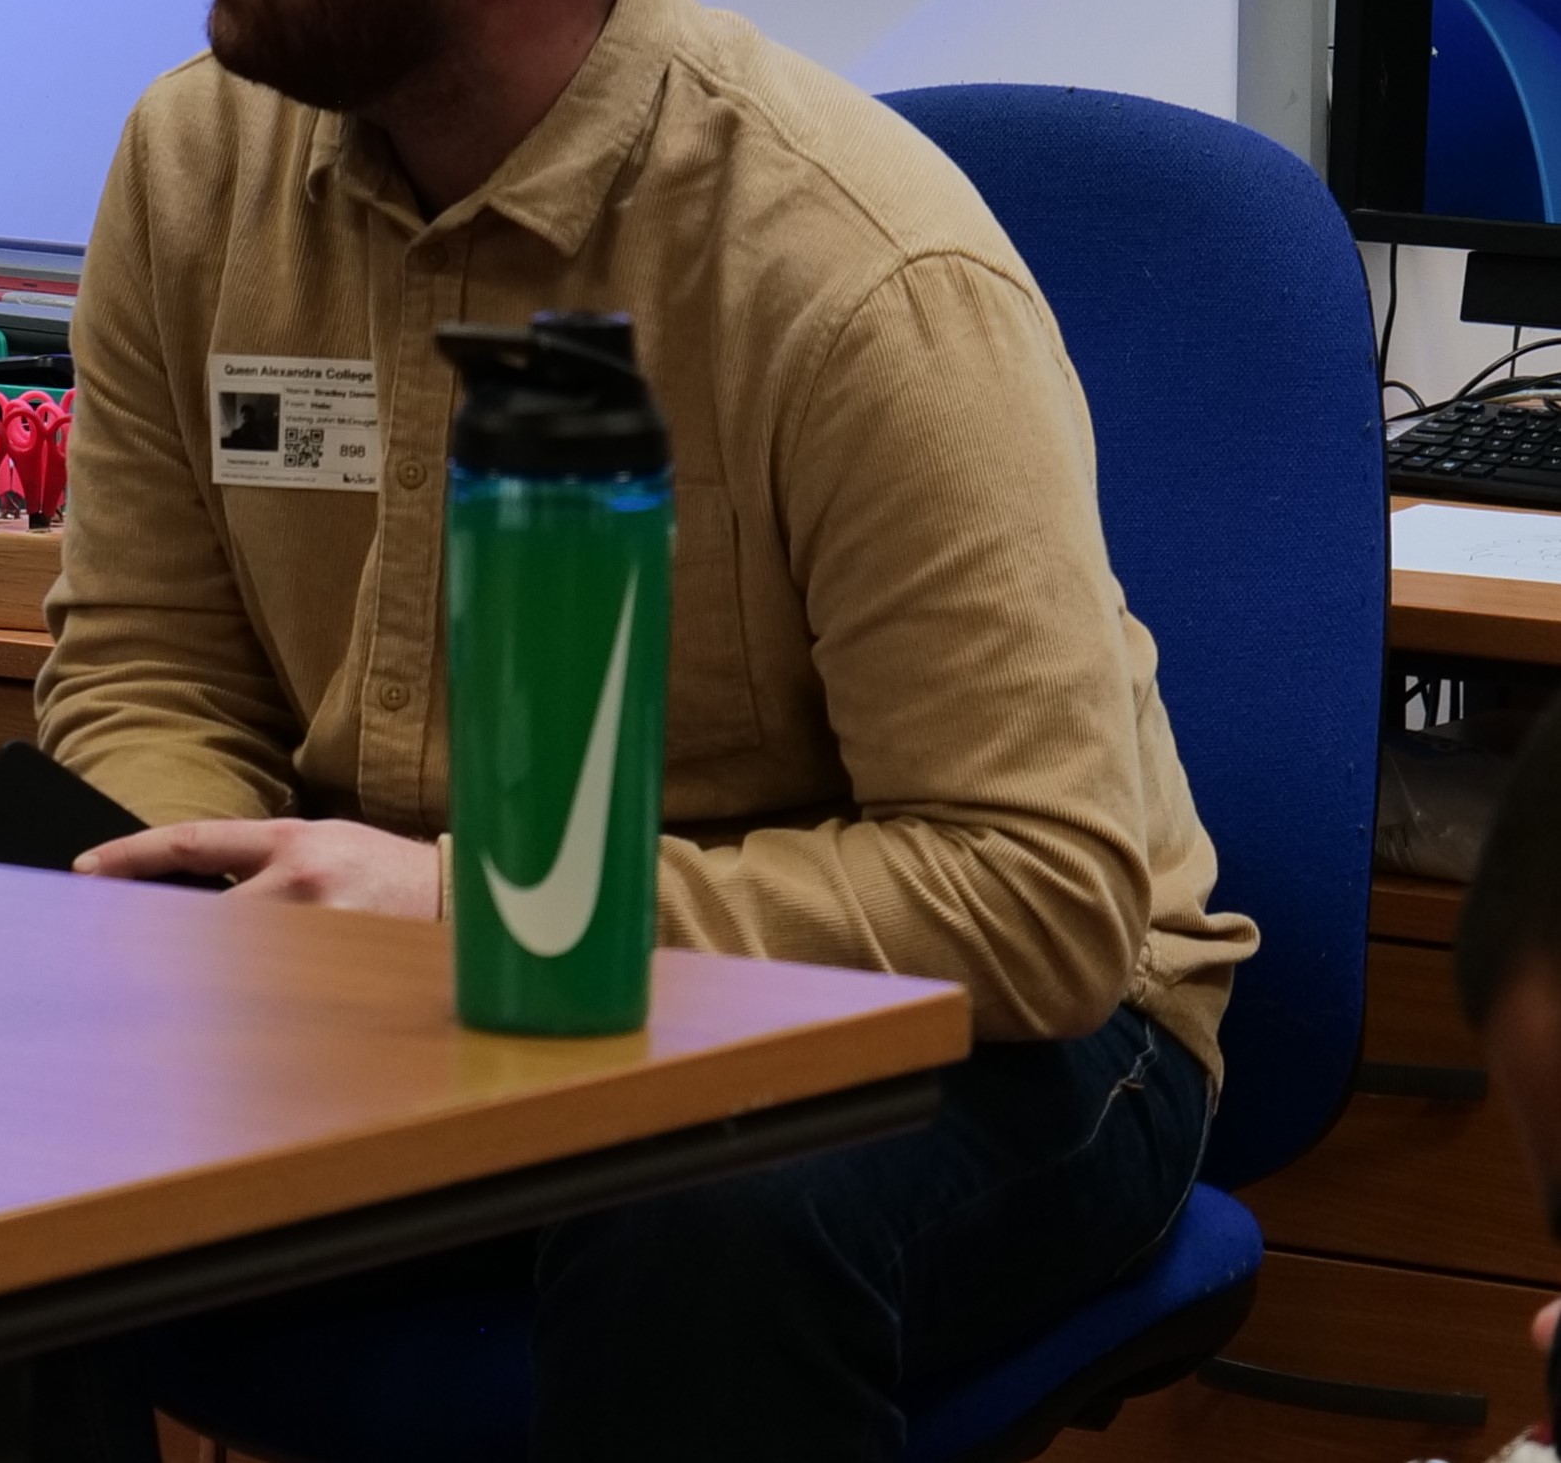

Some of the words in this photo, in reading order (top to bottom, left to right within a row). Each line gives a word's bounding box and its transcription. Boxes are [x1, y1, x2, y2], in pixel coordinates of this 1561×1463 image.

[224, 364, 258, 376] Queen
[261, 365, 322, 378] Alexandra
[326, 367, 373, 383] College
[340, 444, 366, 458] 898
